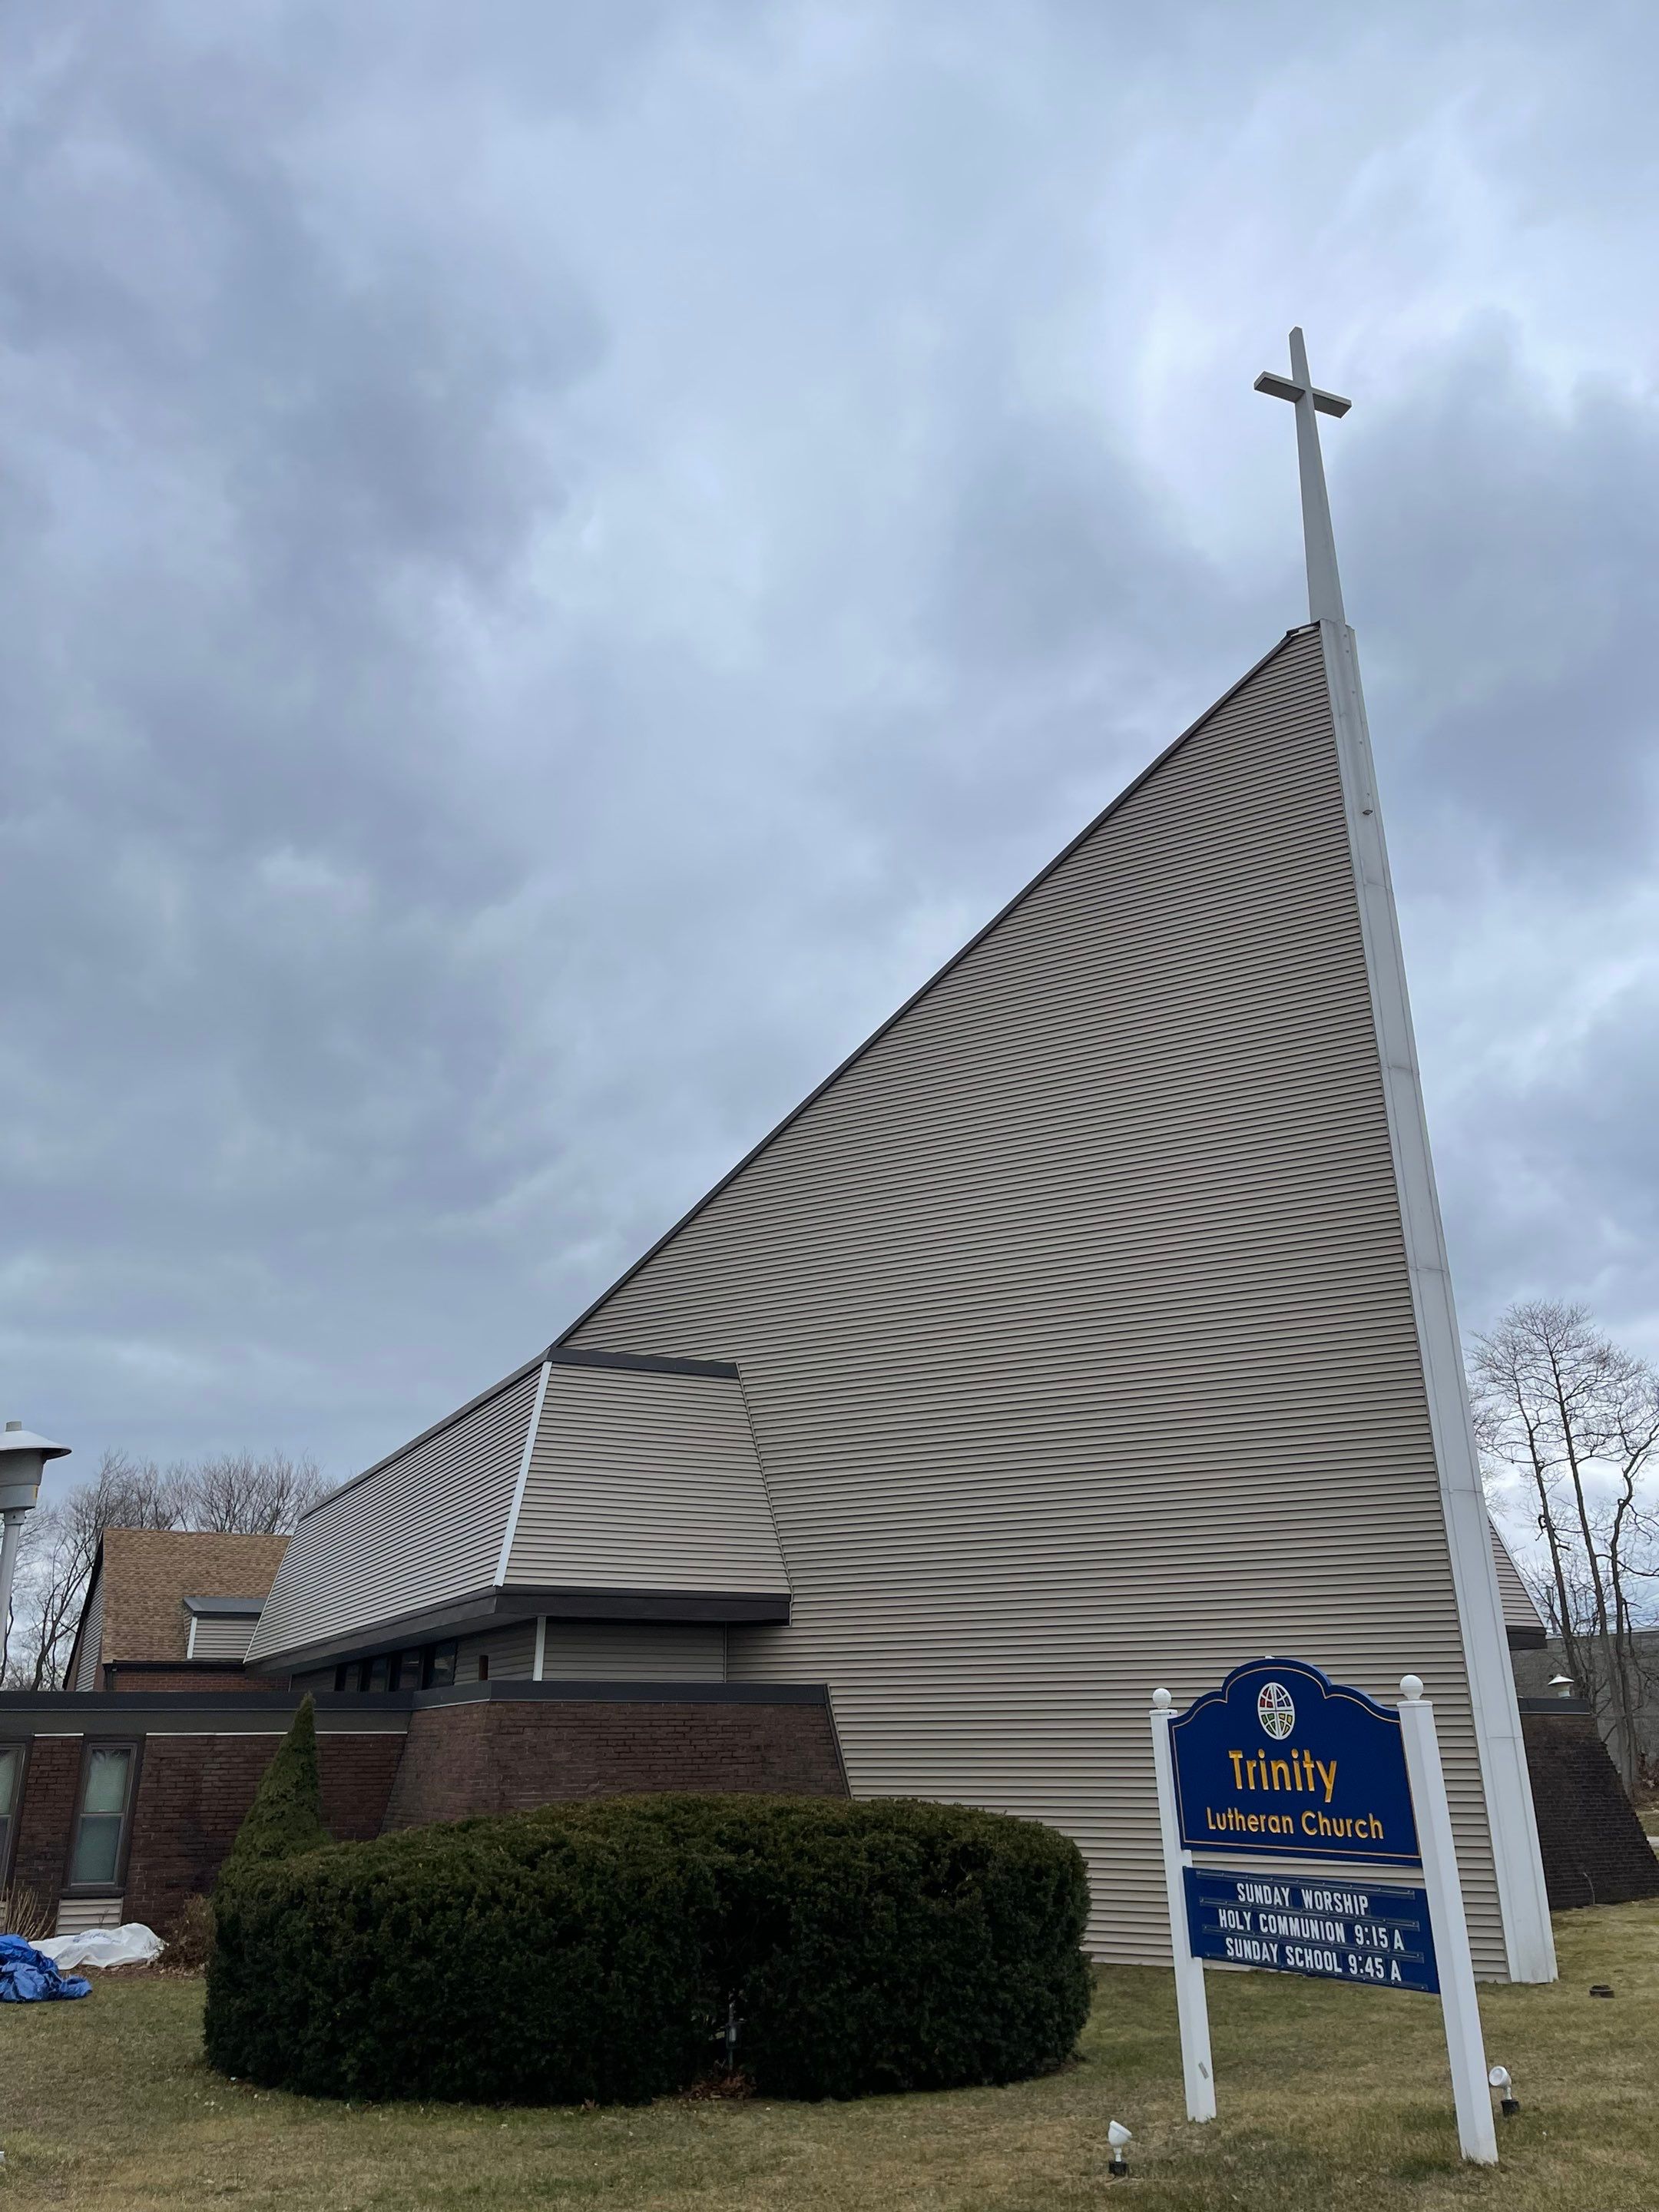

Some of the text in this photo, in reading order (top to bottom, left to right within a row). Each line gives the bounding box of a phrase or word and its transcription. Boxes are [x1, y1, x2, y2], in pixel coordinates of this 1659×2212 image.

[1229, 1749, 1336, 1803] Trinity
[1206, 1807, 1384, 1839] Lutheran Church
[1237, 1883, 1369, 1916] SUNDAY WORSHIP
[1218, 1909, 1405, 1951] HOLY COMMUNION 9:15 A
[1226, 1937, 1402, 1982] SUNDAY SCHOOL 9:45 A
